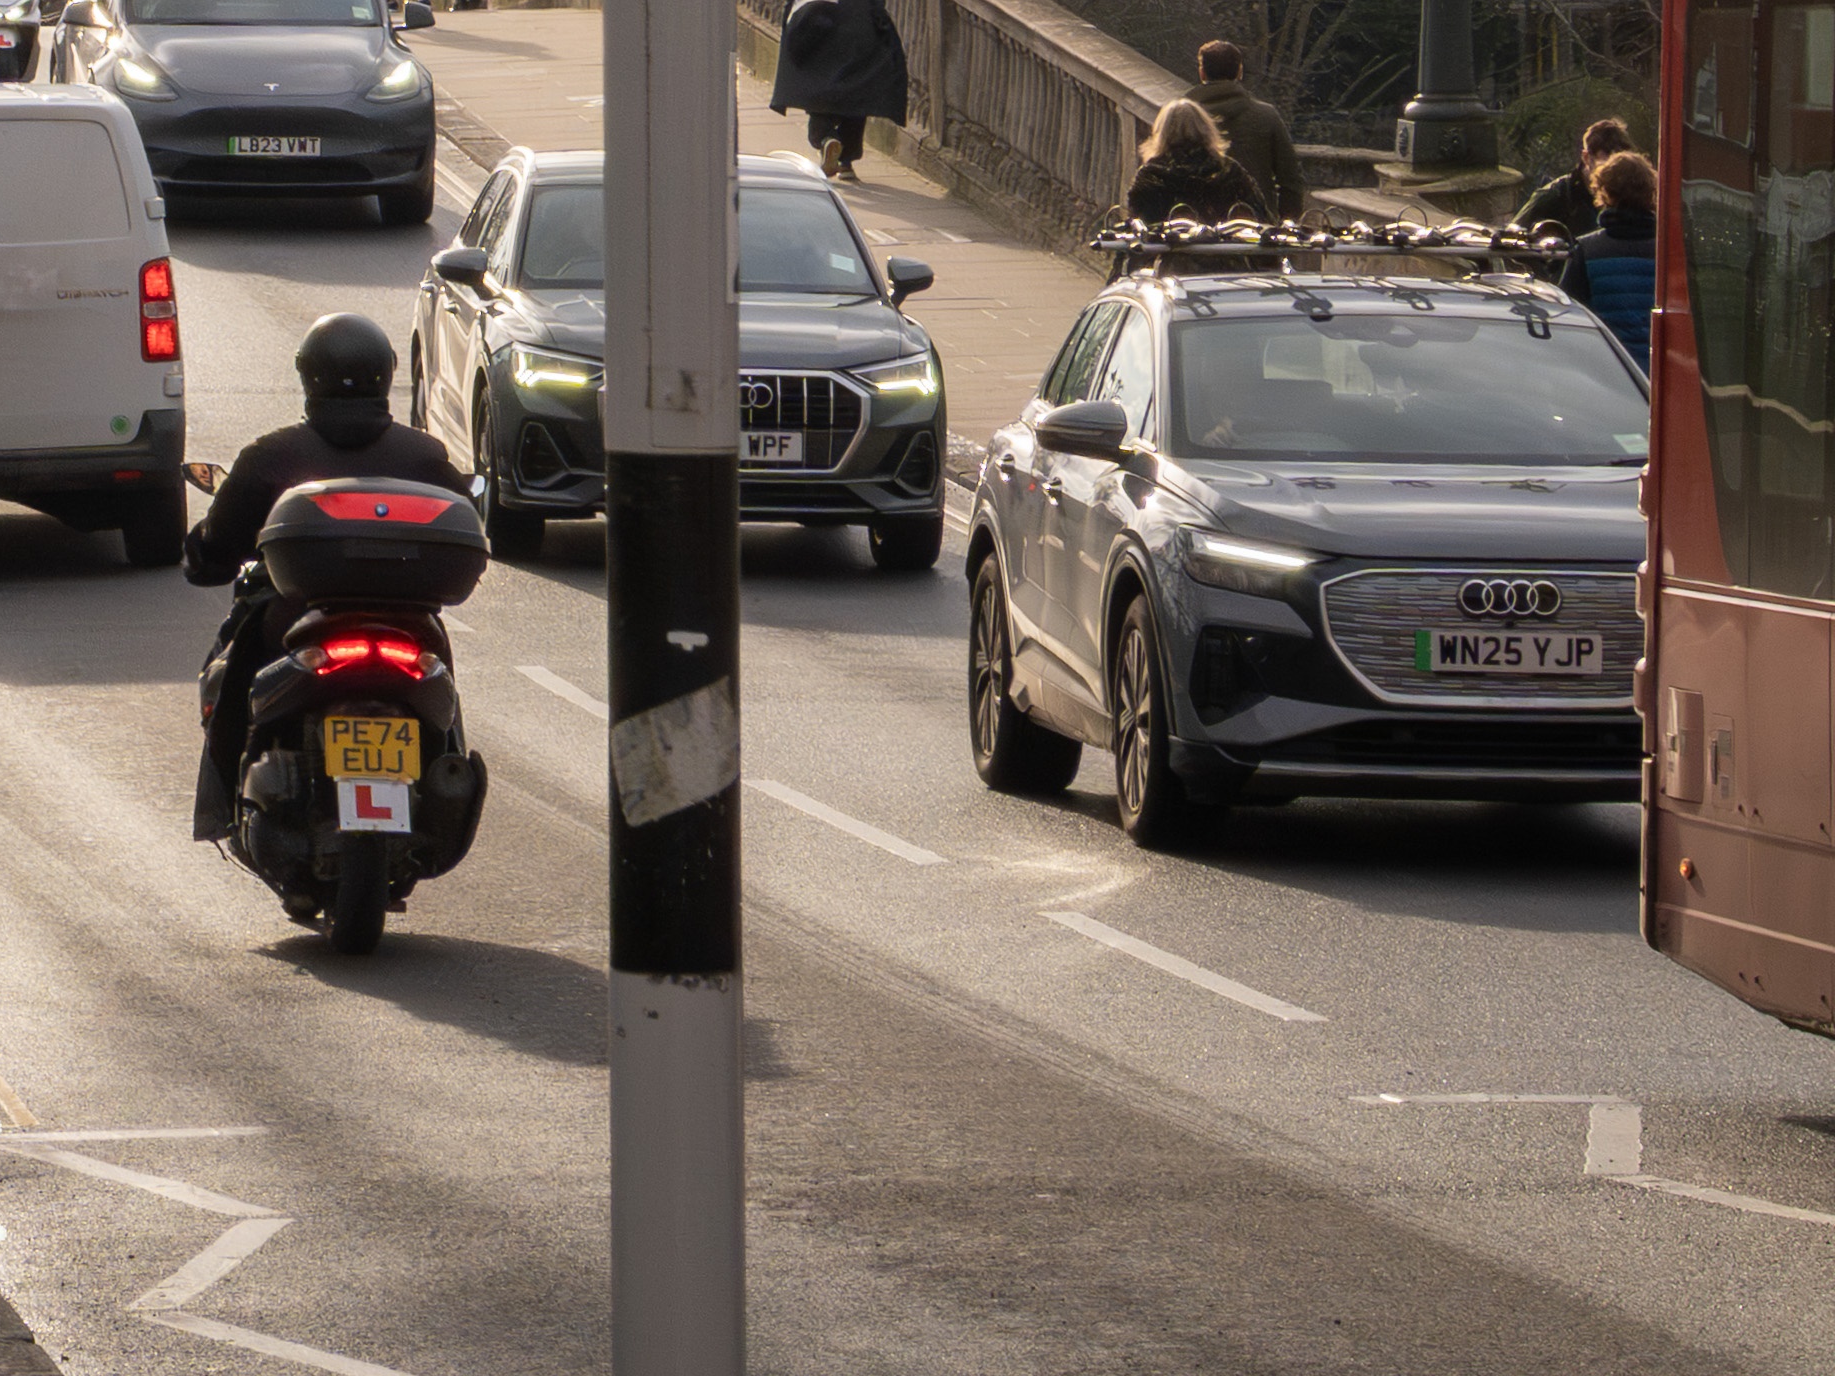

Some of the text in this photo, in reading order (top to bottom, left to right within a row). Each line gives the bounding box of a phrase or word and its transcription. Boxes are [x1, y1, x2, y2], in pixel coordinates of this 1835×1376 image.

[238, 137, 282, 153] LB23
[747, 435, 791, 457] WPF
[1439, 634, 1594, 667] WN25 YJP
[332, 720, 413, 746] PE74
[343, 748, 404, 775] EUJ
[355, 784, 392, 820] L
